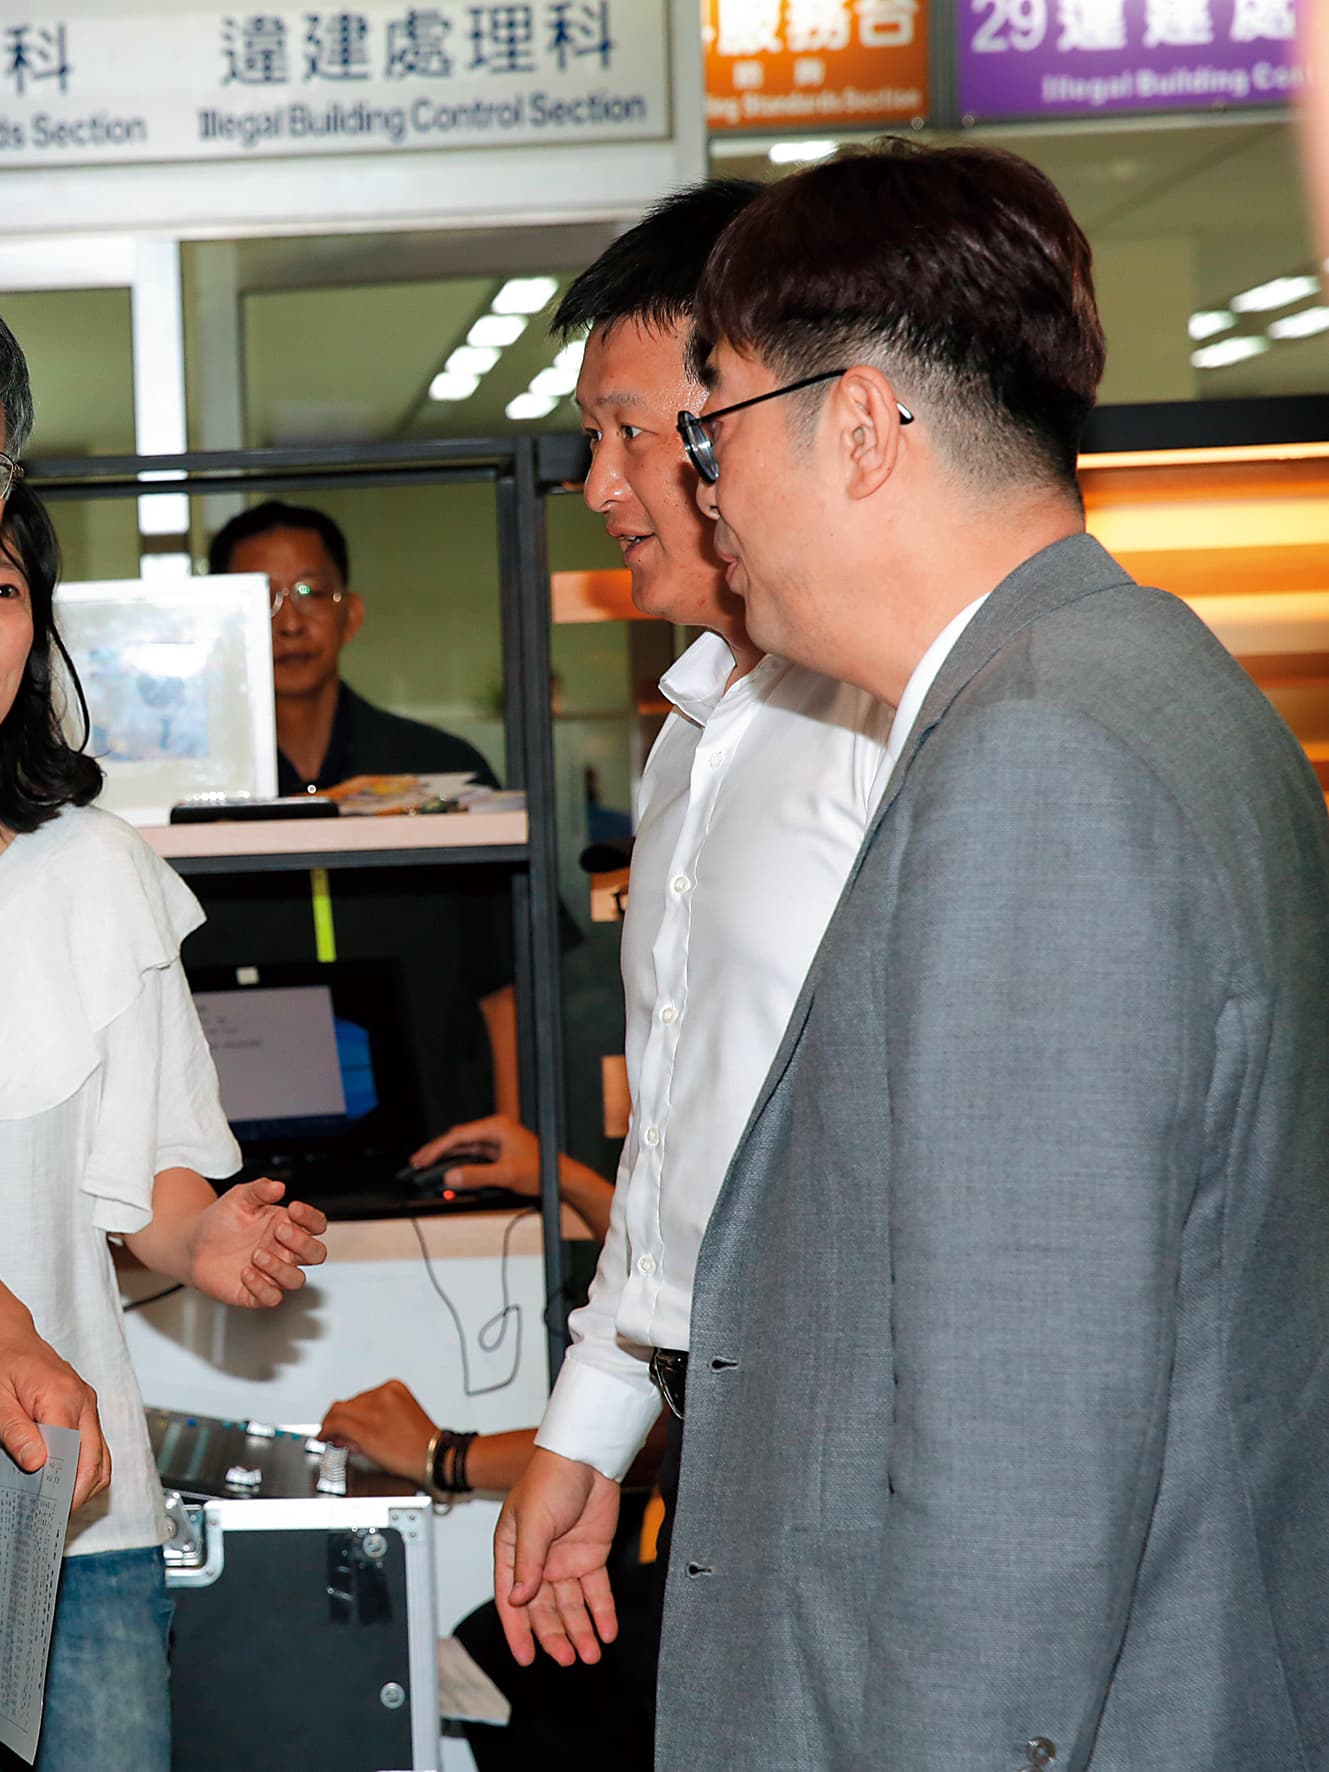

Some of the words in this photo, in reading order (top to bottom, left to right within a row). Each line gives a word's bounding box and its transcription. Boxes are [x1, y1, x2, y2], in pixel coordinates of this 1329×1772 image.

[221, 0, 615, 87] 違建處理科
[971, 0, 1048, 53] 29
[1041, 70, 1133, 105] Illegal
[1135, 65, 1250, 98] Building
[30, 110, 147, 147] Section
[198, 107, 280, 148] Illegal
[288, 103, 407, 143] Building
[410, 96, 525, 134] Control
[529, 88, 648, 128] Section
